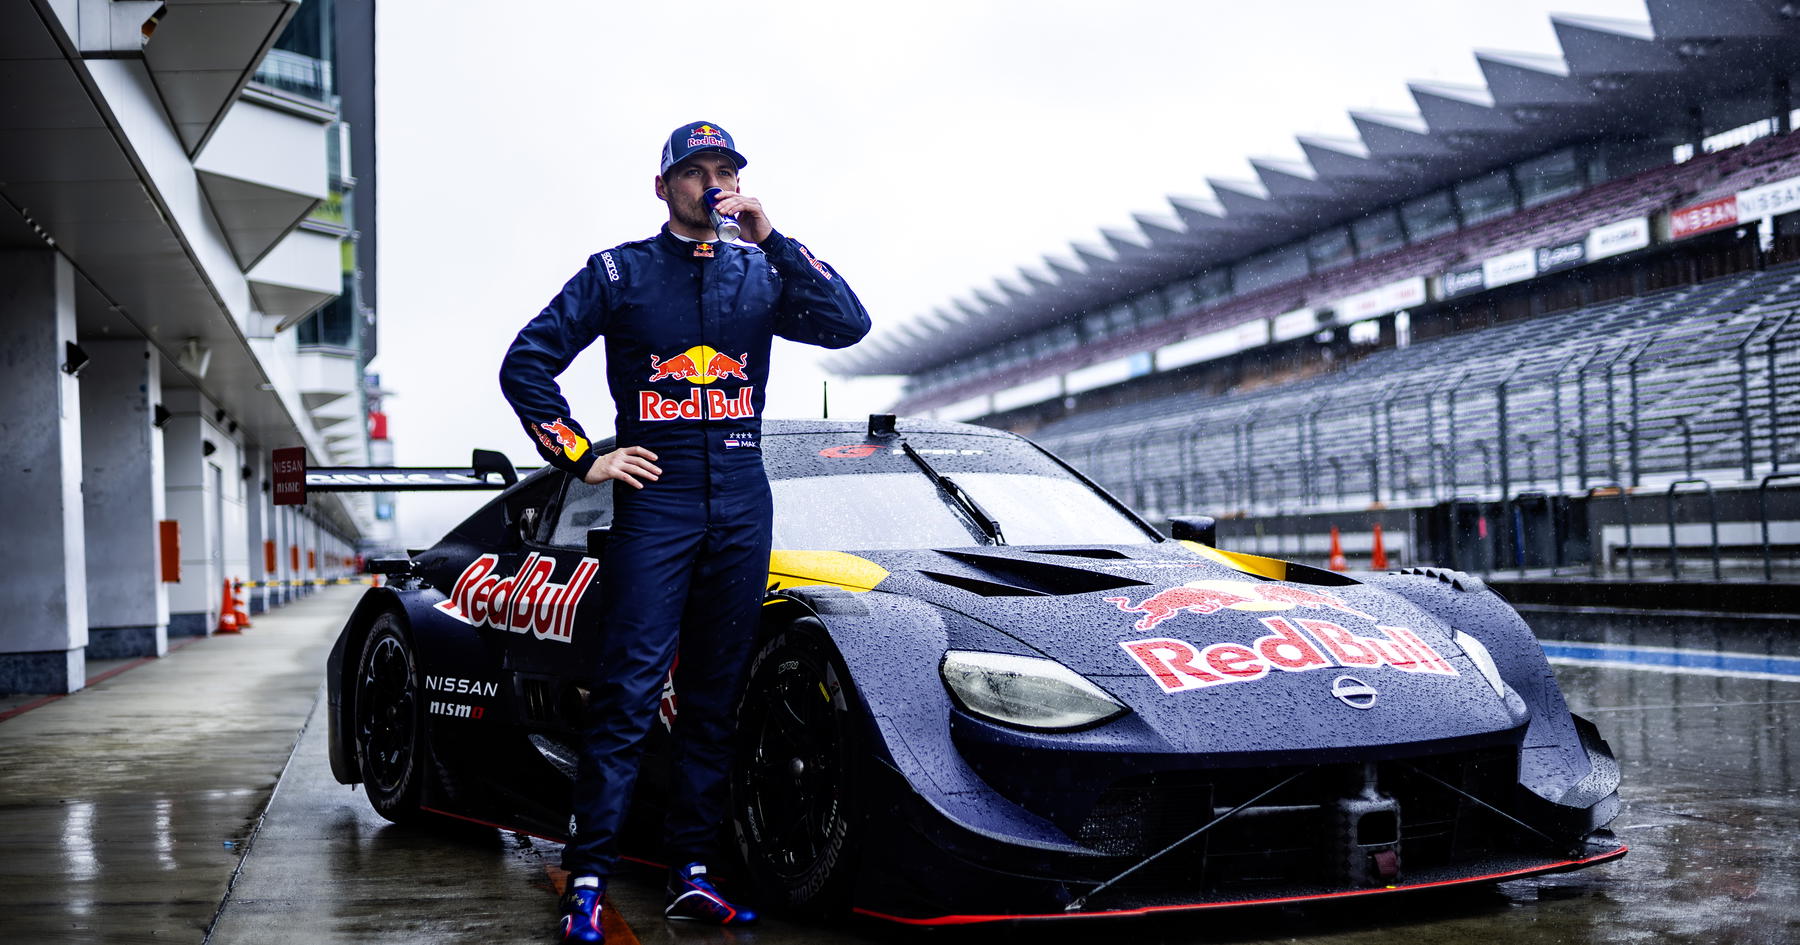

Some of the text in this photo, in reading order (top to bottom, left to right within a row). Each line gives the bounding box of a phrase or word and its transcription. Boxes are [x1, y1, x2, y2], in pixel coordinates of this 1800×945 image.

[688, 136, 728, 148] Red Bull
[602, 252, 620, 281] sparco
[639, 386, 755, 421] Red Bull
[273, 459, 303, 473] NISSAN
[433, 552, 600, 643] Red Bull
[1118, 615, 1461, 694] Red Bull
[425, 675, 498, 697] NISSAN
[429, 701, 485, 720] nismo
